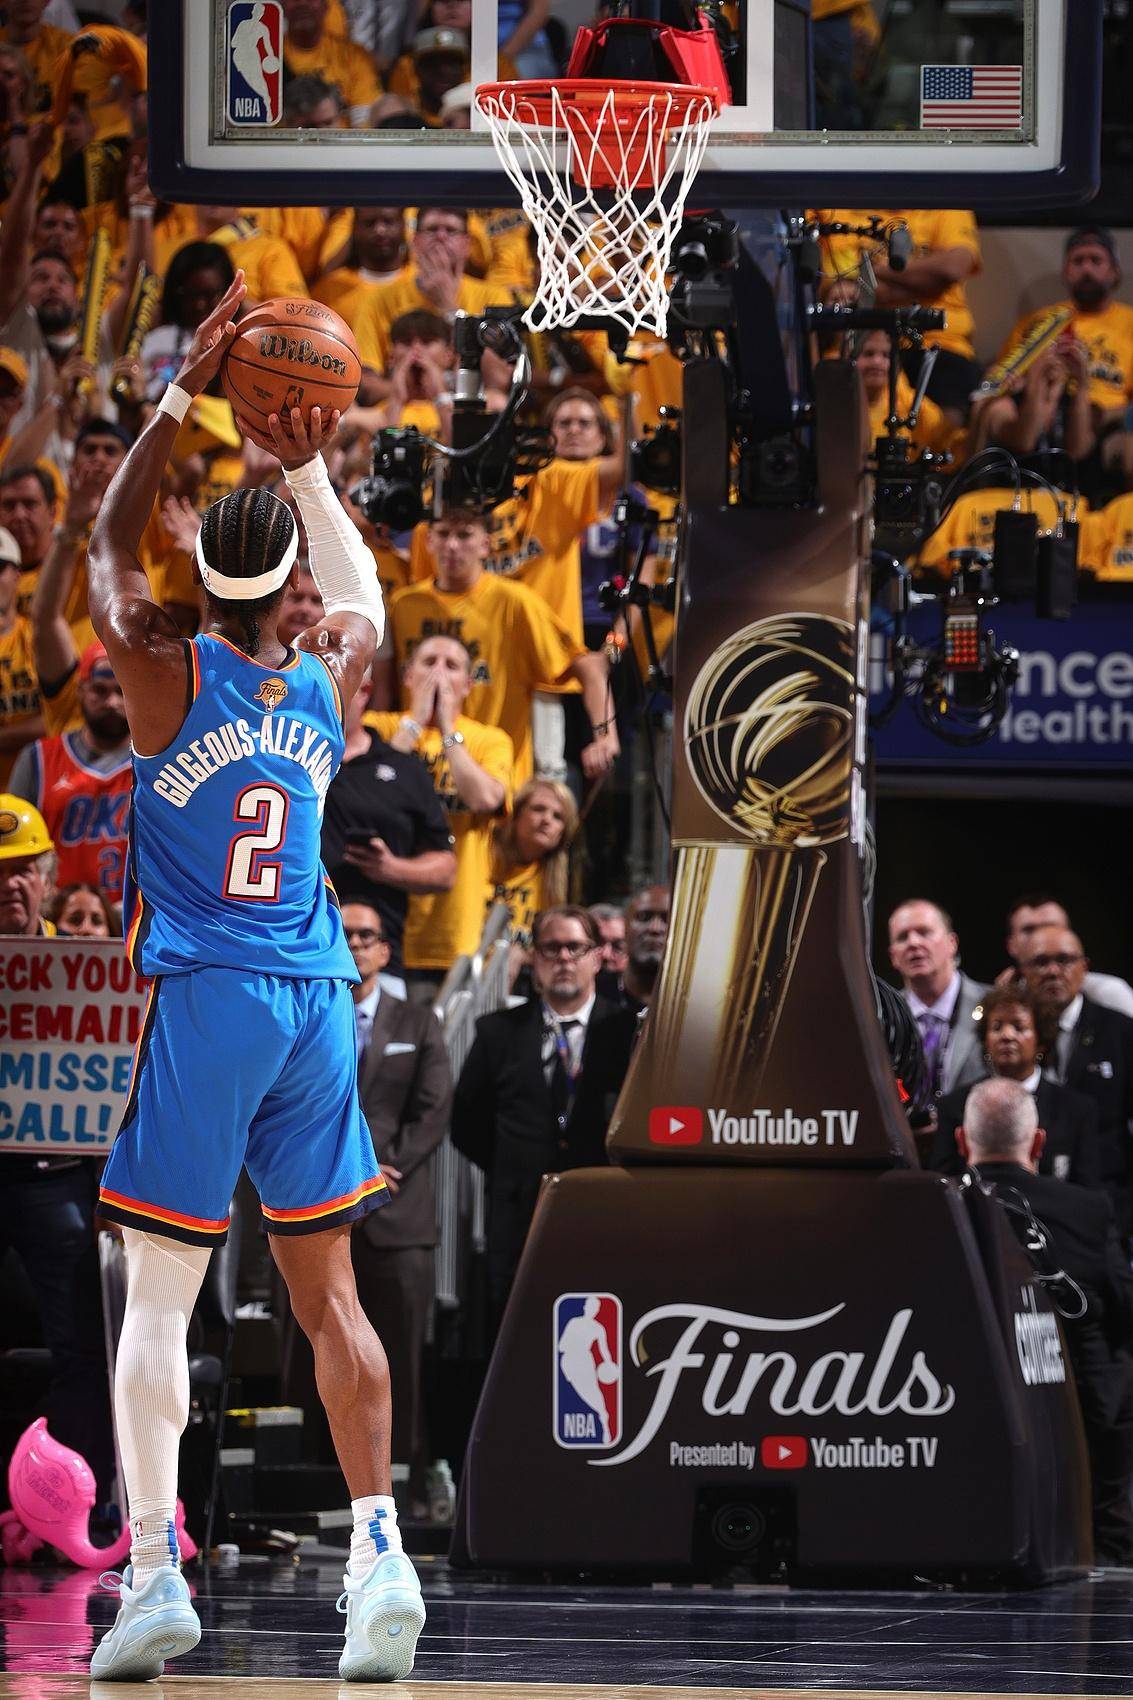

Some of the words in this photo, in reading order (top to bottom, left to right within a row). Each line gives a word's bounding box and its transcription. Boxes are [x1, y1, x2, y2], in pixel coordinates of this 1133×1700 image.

[235, 98, 260, 117] NBA
[261, 335, 347, 377] Wilson
[254, 682, 288, 700] Finals
[61, 792, 130, 846] OK
[221, 781, 289, 902] 2
[0, 1052, 132, 1093] MISSE
[707, 1108, 819, 1146] YouTube
[821, 1109, 859, 1146] TV
[563, 1412, 597, 1439] NBA
[587, 1302, 956, 1467] Finals
[670, 1441, 737, 1467] Presented
[738, 1442, 755, 1469] by
[811, 1436, 904, 1468] YouTube
[906, 1437, 938, 1468] TV
